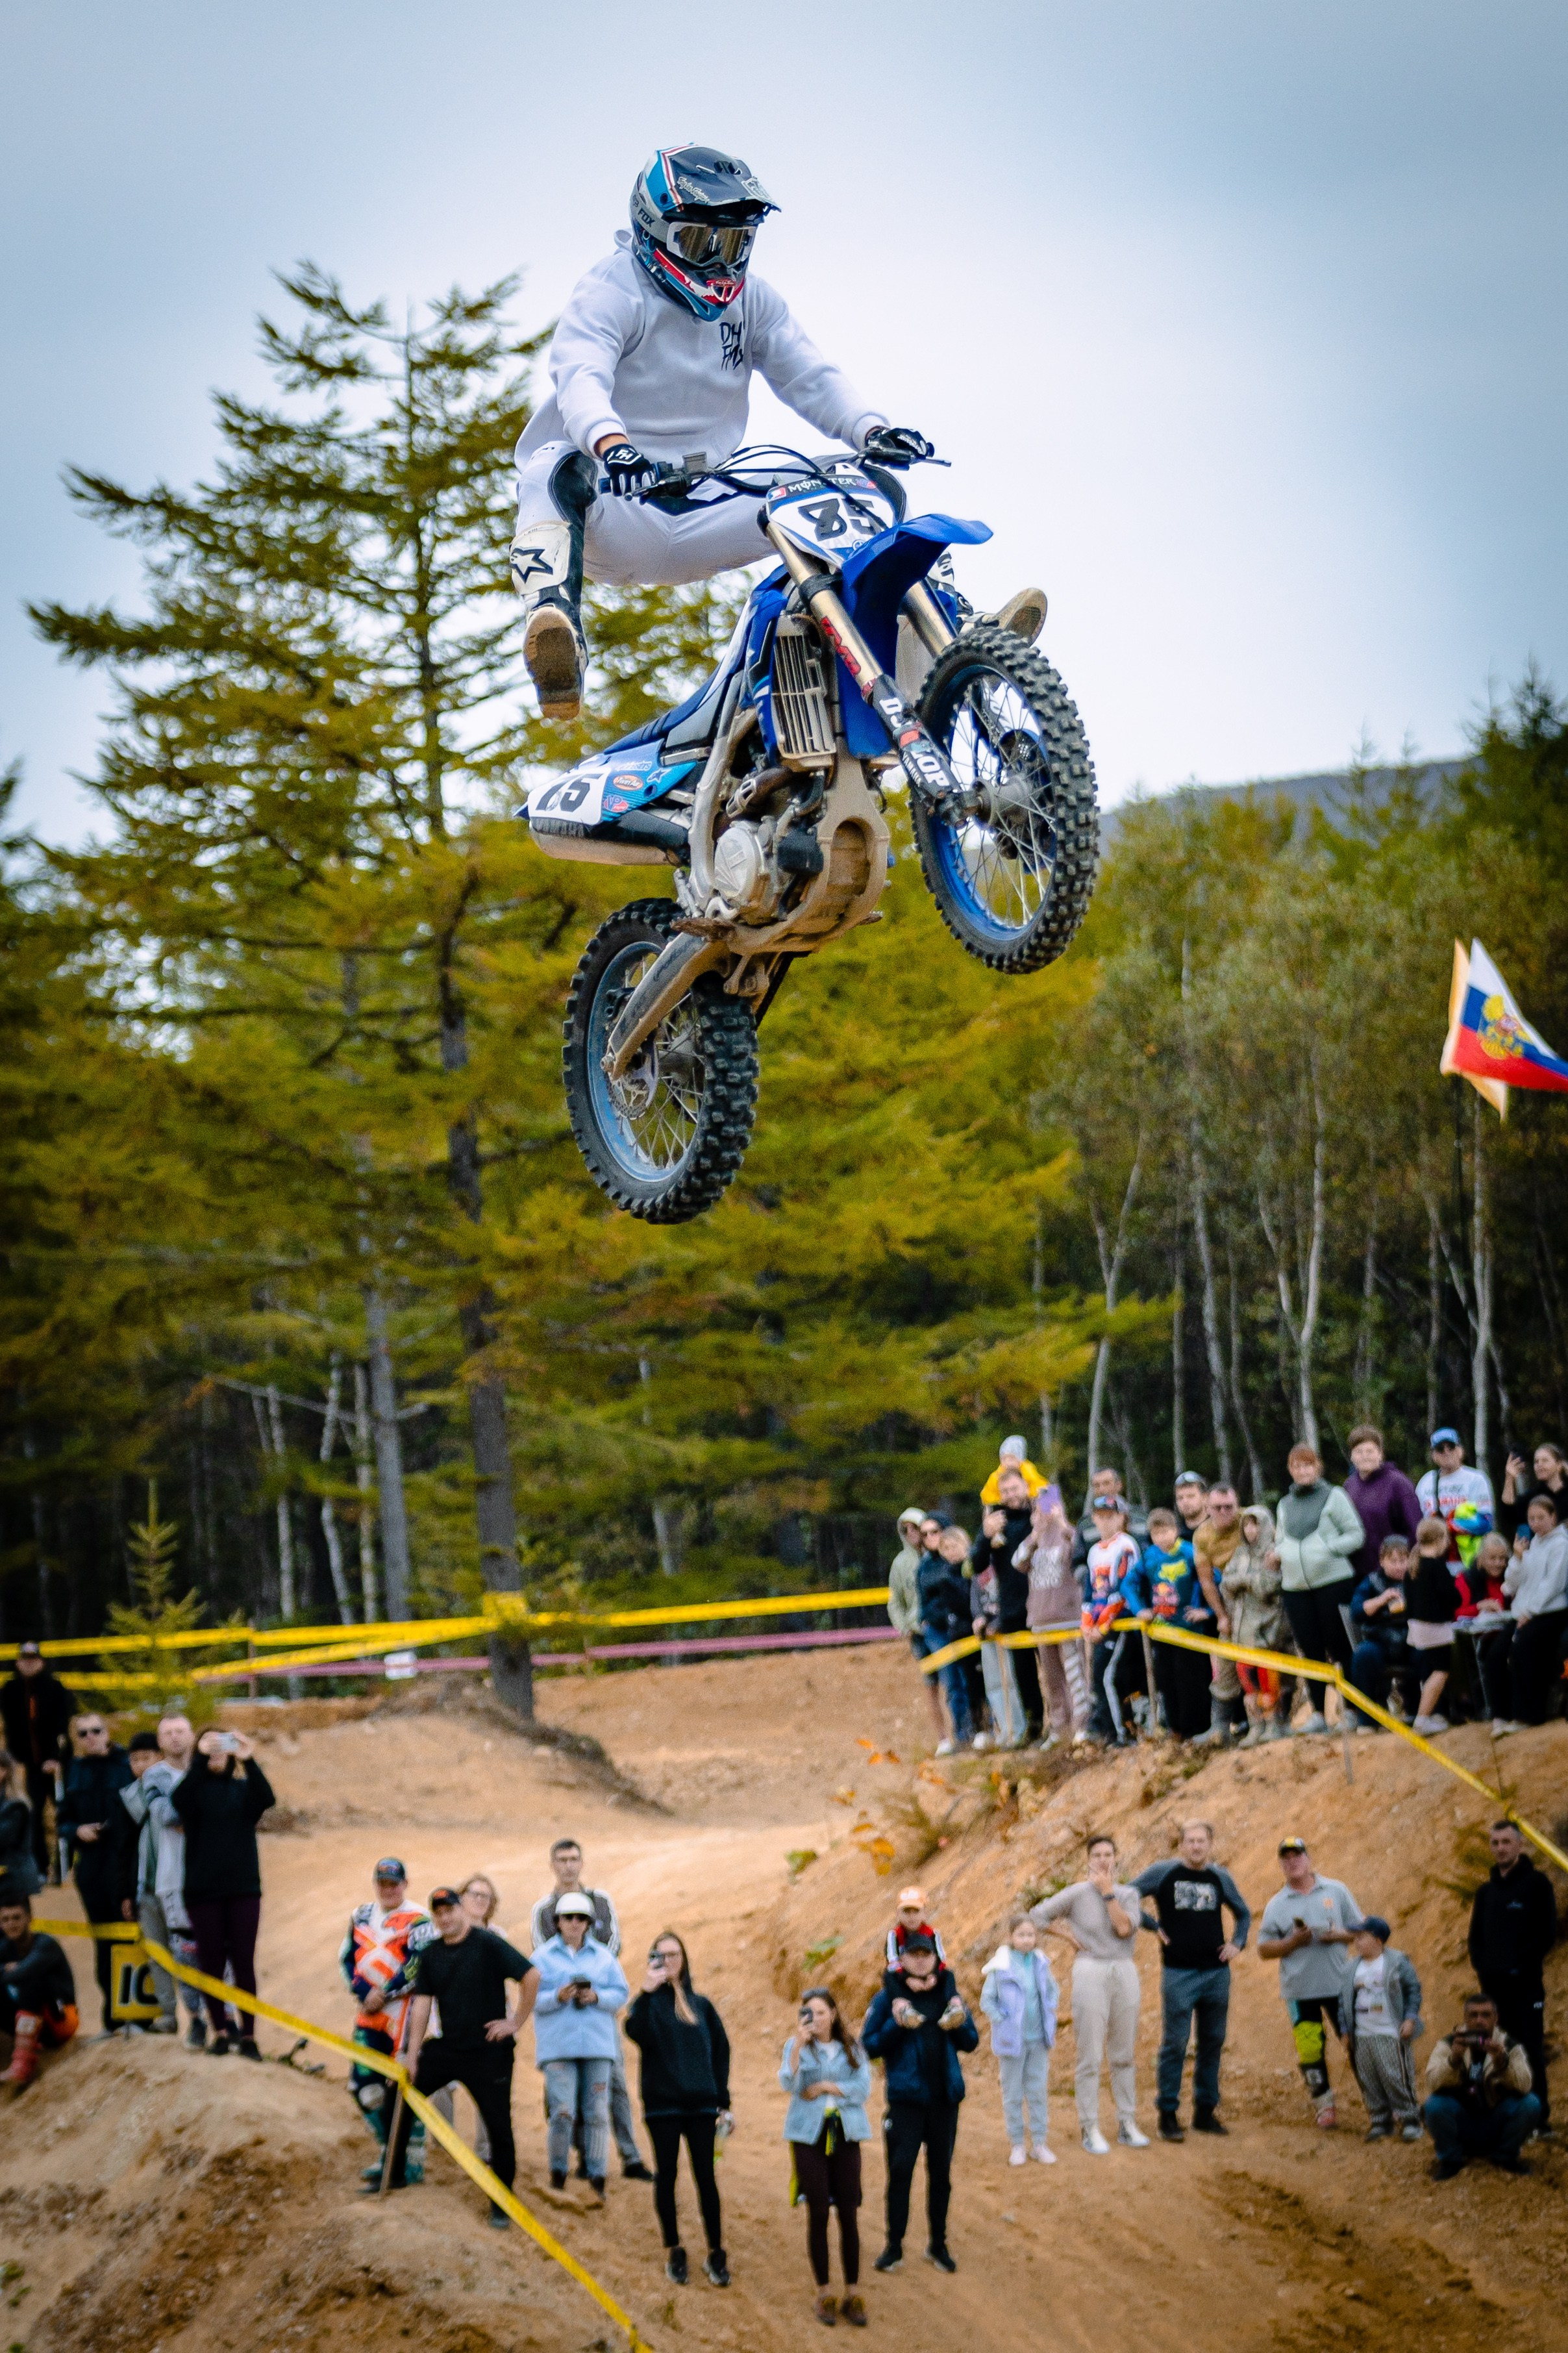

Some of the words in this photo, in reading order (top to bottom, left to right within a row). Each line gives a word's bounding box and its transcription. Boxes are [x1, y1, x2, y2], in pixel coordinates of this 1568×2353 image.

[638, 208, 655, 227] FOX
[788, 477, 857, 493] MONTER
[606, 794, 623, 811] VP
